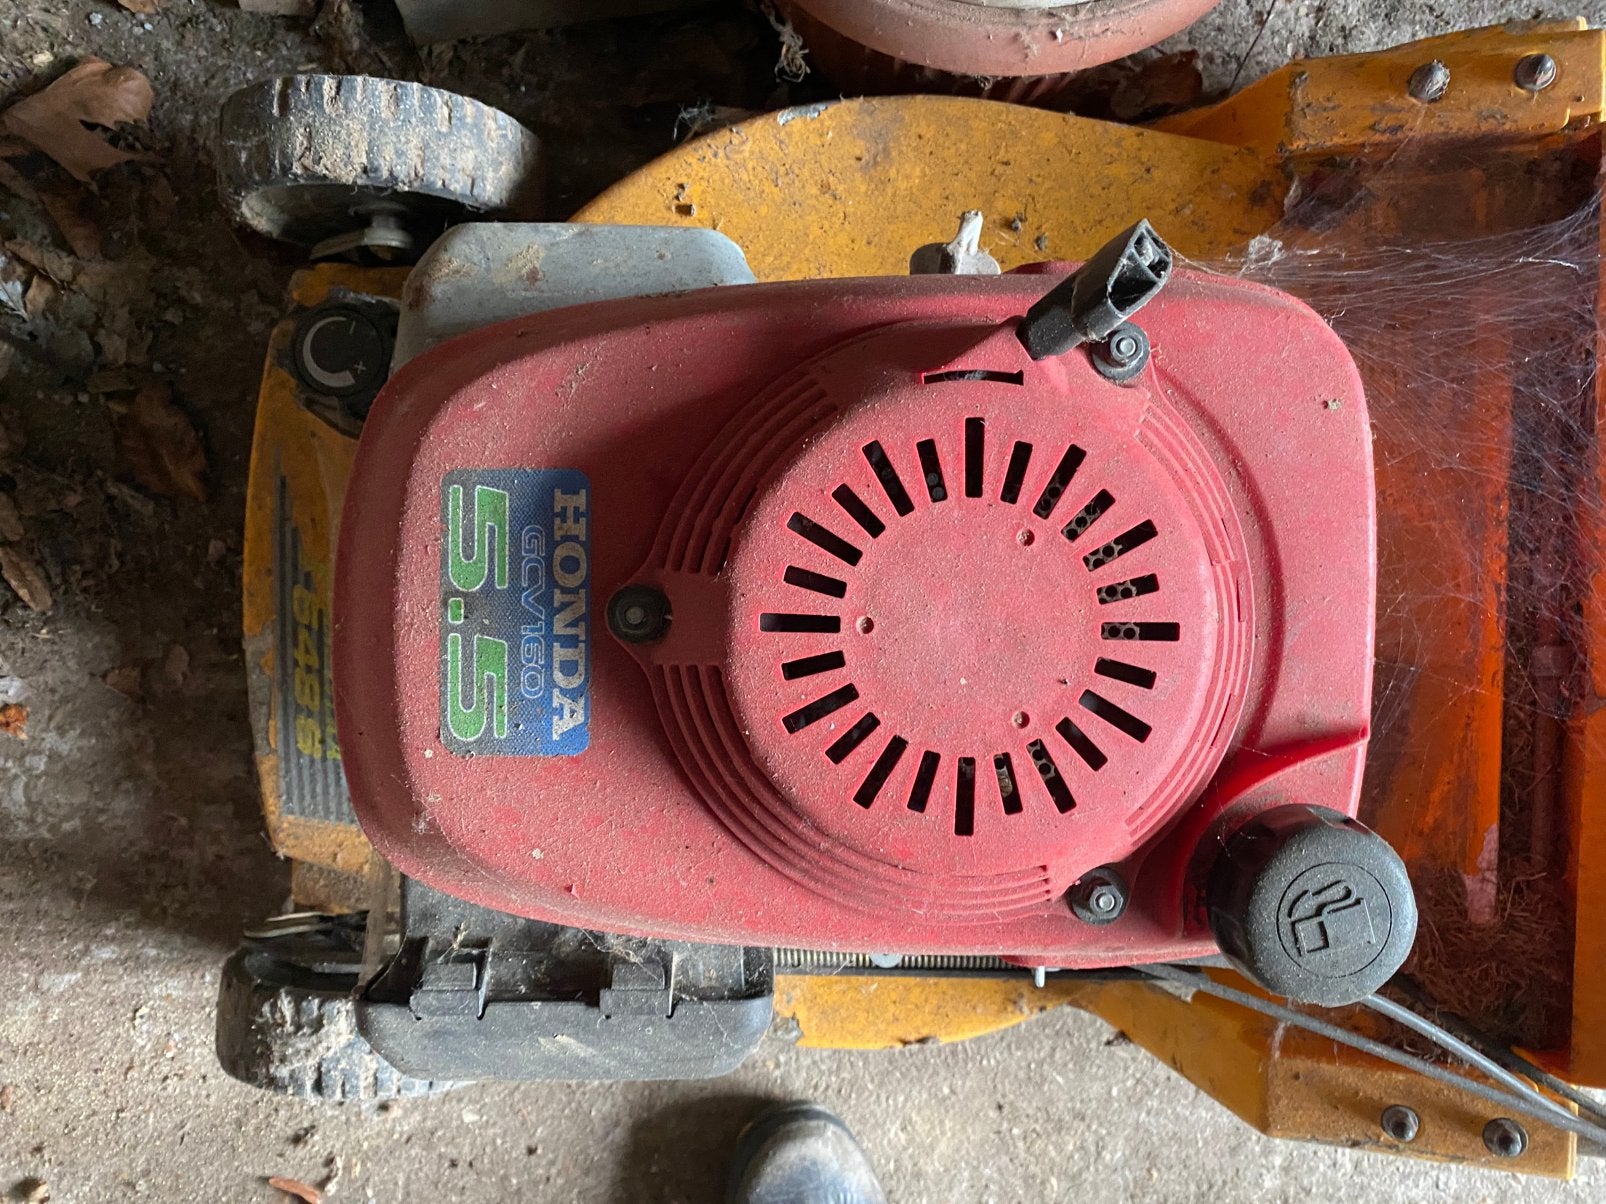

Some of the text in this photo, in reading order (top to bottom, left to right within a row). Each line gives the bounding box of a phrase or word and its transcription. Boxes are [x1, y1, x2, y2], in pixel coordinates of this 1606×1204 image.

[448, 484, 509, 741] 5.5
[521, 524, 546, 699] GCV160
[552, 488, 587, 741] HONDA
